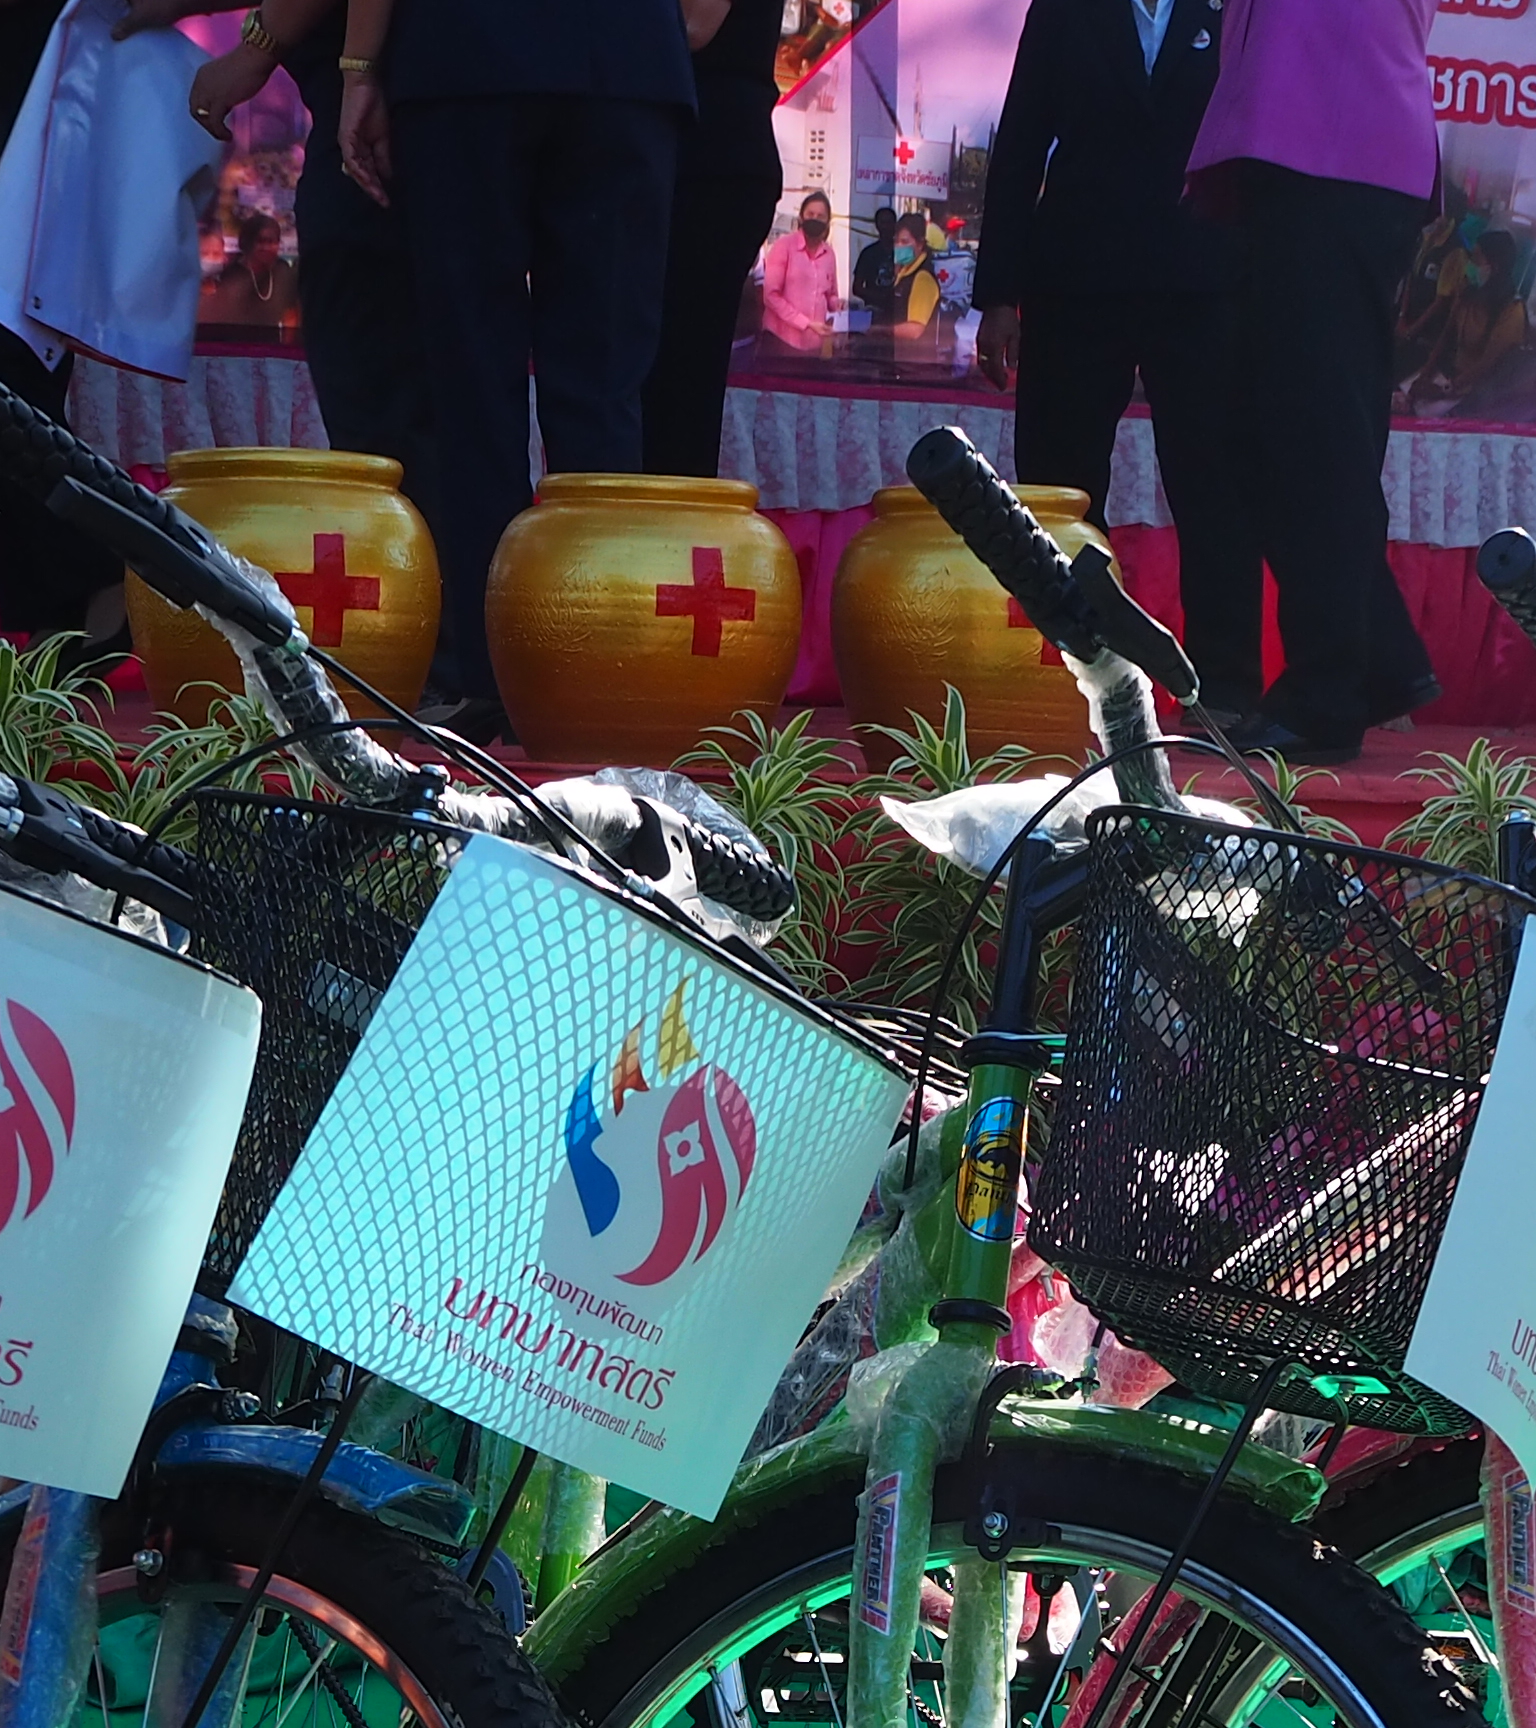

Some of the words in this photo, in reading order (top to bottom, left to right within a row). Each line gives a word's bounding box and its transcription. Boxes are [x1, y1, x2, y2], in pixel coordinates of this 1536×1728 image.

[444, 1278, 676, 1410] บทบาทสตรี
[519, 1264, 664, 1345] กองทุนพัฒนา
[388, 1303, 437, 1342] Thai
[445, 1329, 514, 1383] Women
[520, 1368, 631, 1435] Empowerment
[630, 1419, 667, 1452] Funds
